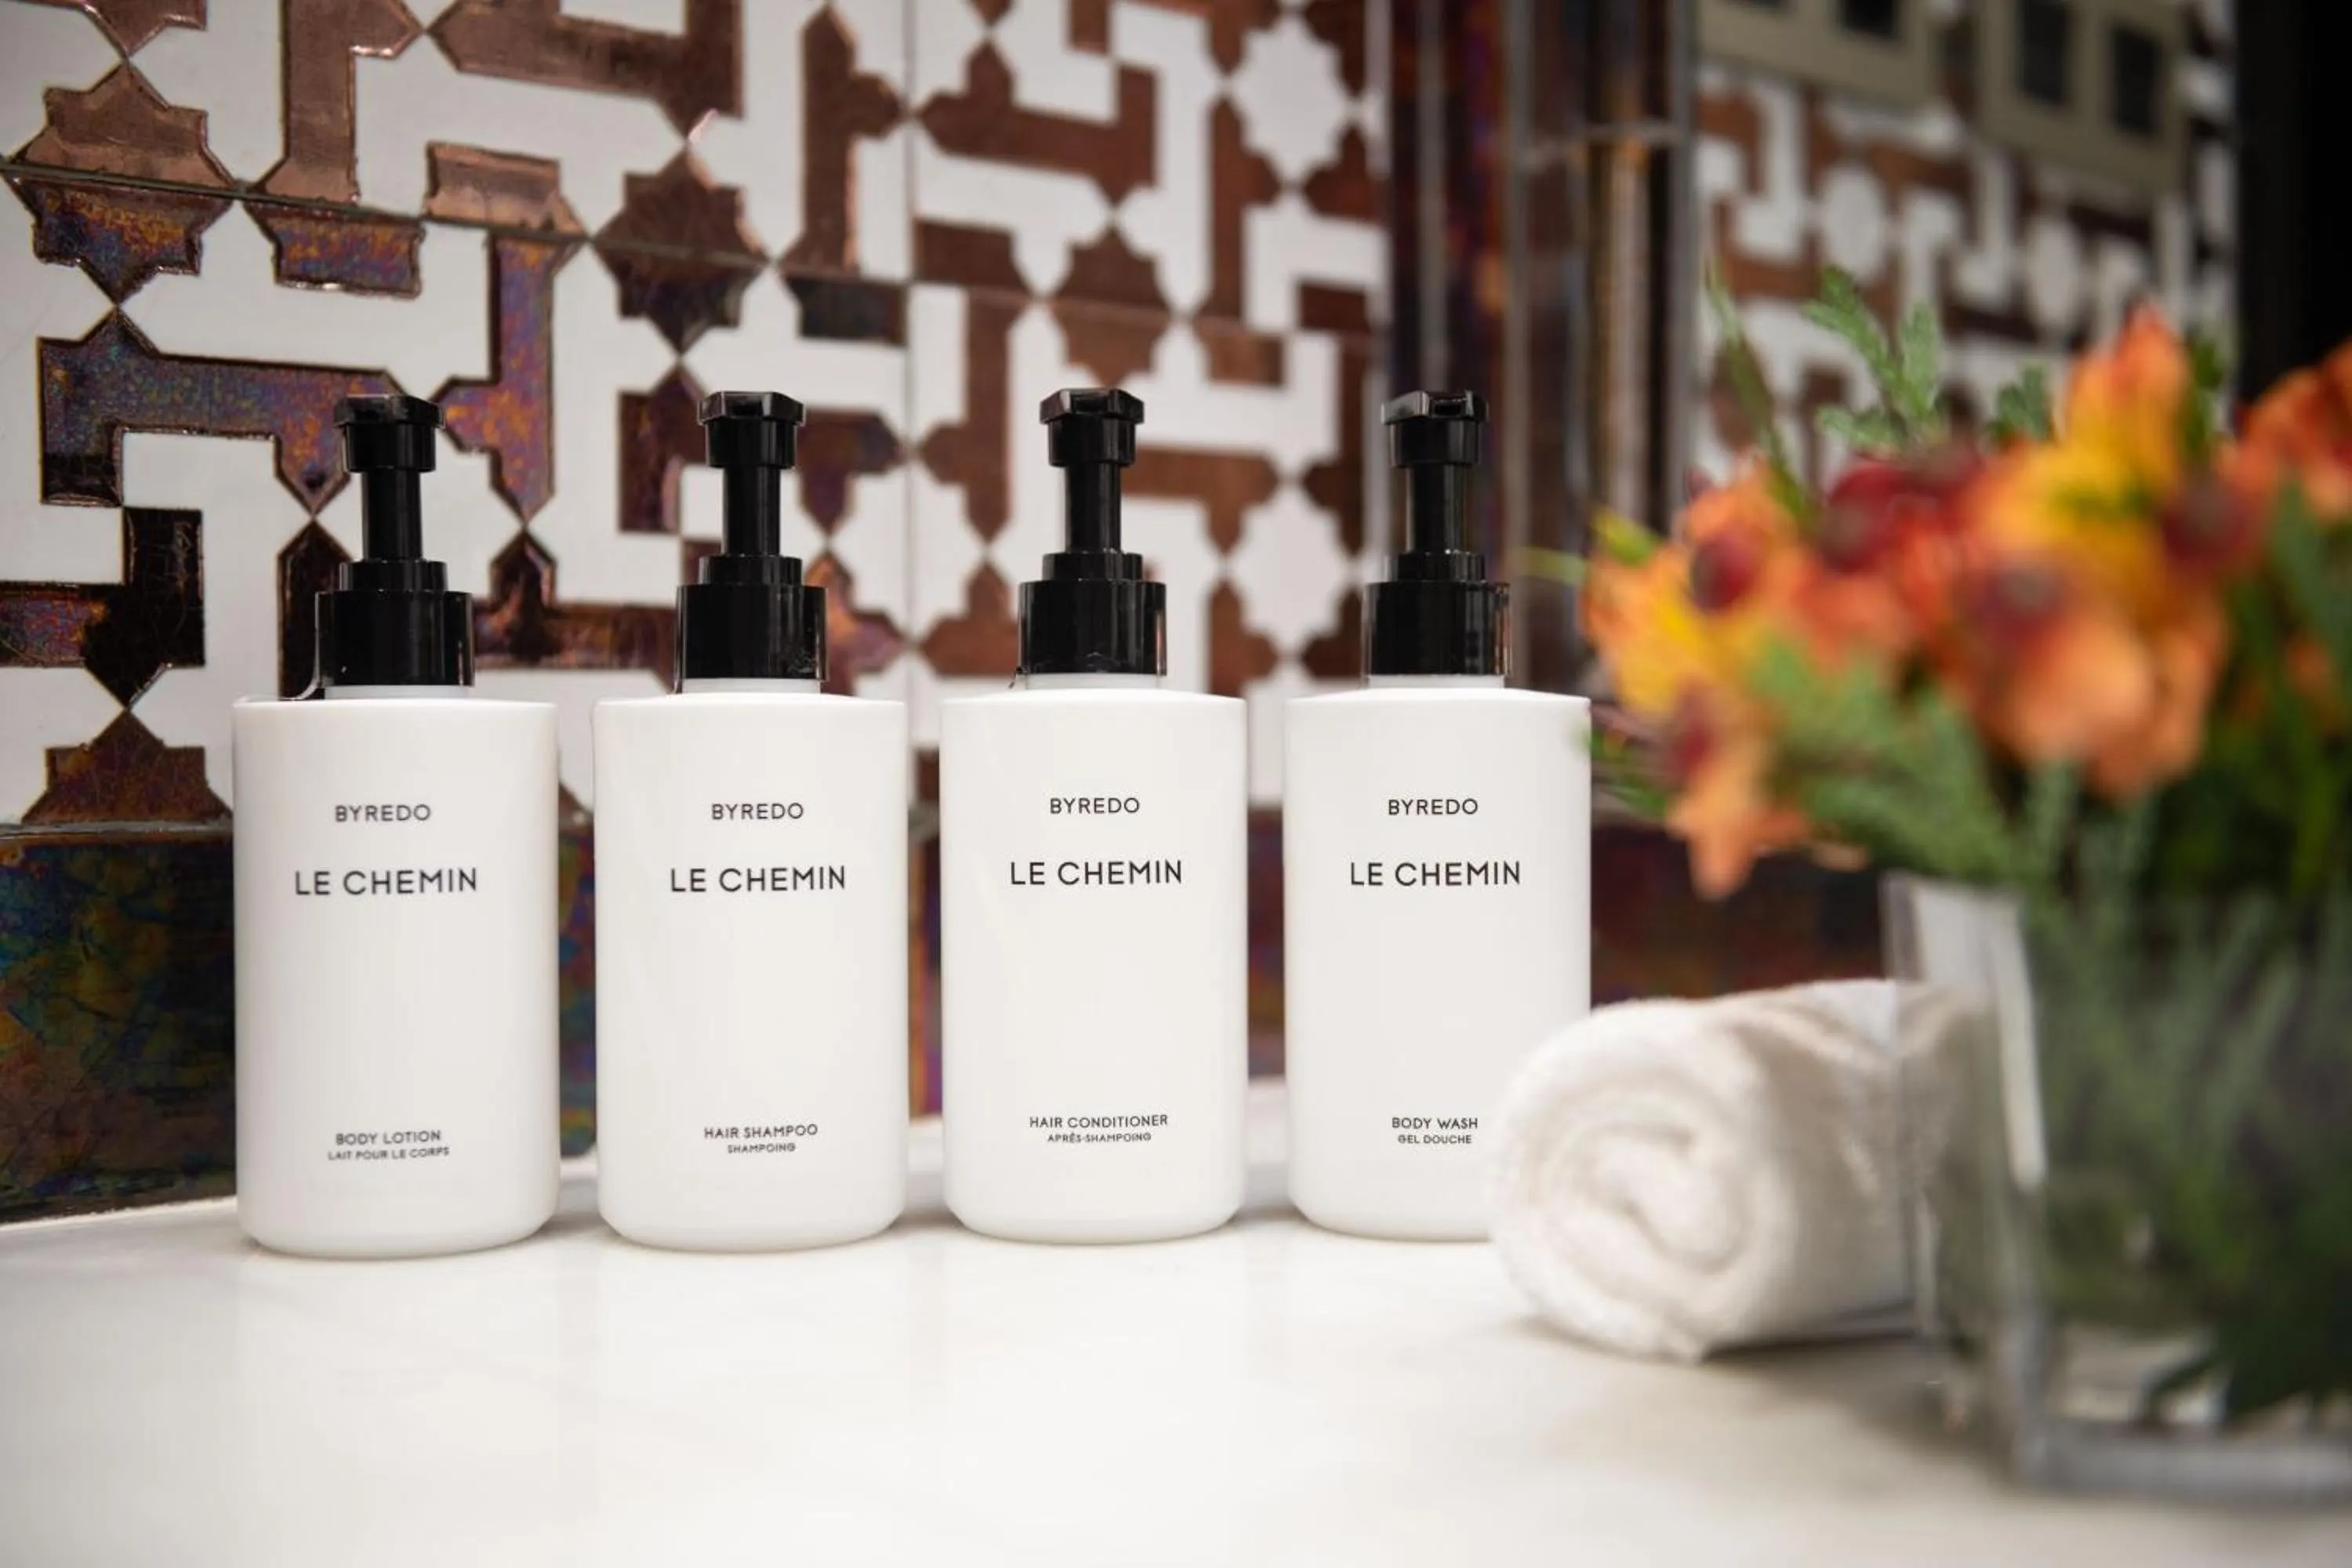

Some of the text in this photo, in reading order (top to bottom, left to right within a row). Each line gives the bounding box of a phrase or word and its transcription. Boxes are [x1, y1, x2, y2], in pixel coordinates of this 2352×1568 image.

[334, 803, 432, 823] BYREDO
[710, 801, 804, 821] BYREDO
[1049, 796, 1141, 815] BYREDO
[1388, 797, 1479, 816] BYREDO
[295, 866, 477, 897] LE CHEMIN
[670, 864, 846, 894] LE CHEMIN
[1010, 858, 1182, 887] LE CHEMIN
[1350, 860, 1521, 887] LE CHEMIN
[1029, 1113, 1168, 1129] HAIR CONDITIONER
[1392, 1116, 1479, 1131] BODY WASH
[335, 1129, 442, 1146] BODY LOTION
[703, 1123, 818, 1140] HAIR SHAMPOO
[1397, 1134, 1472, 1145] GEL DOUCHE
[328, 1145, 450, 1161] LAIT POUR LE CORPS
[727, 1142, 797, 1155] SHAMPOING
